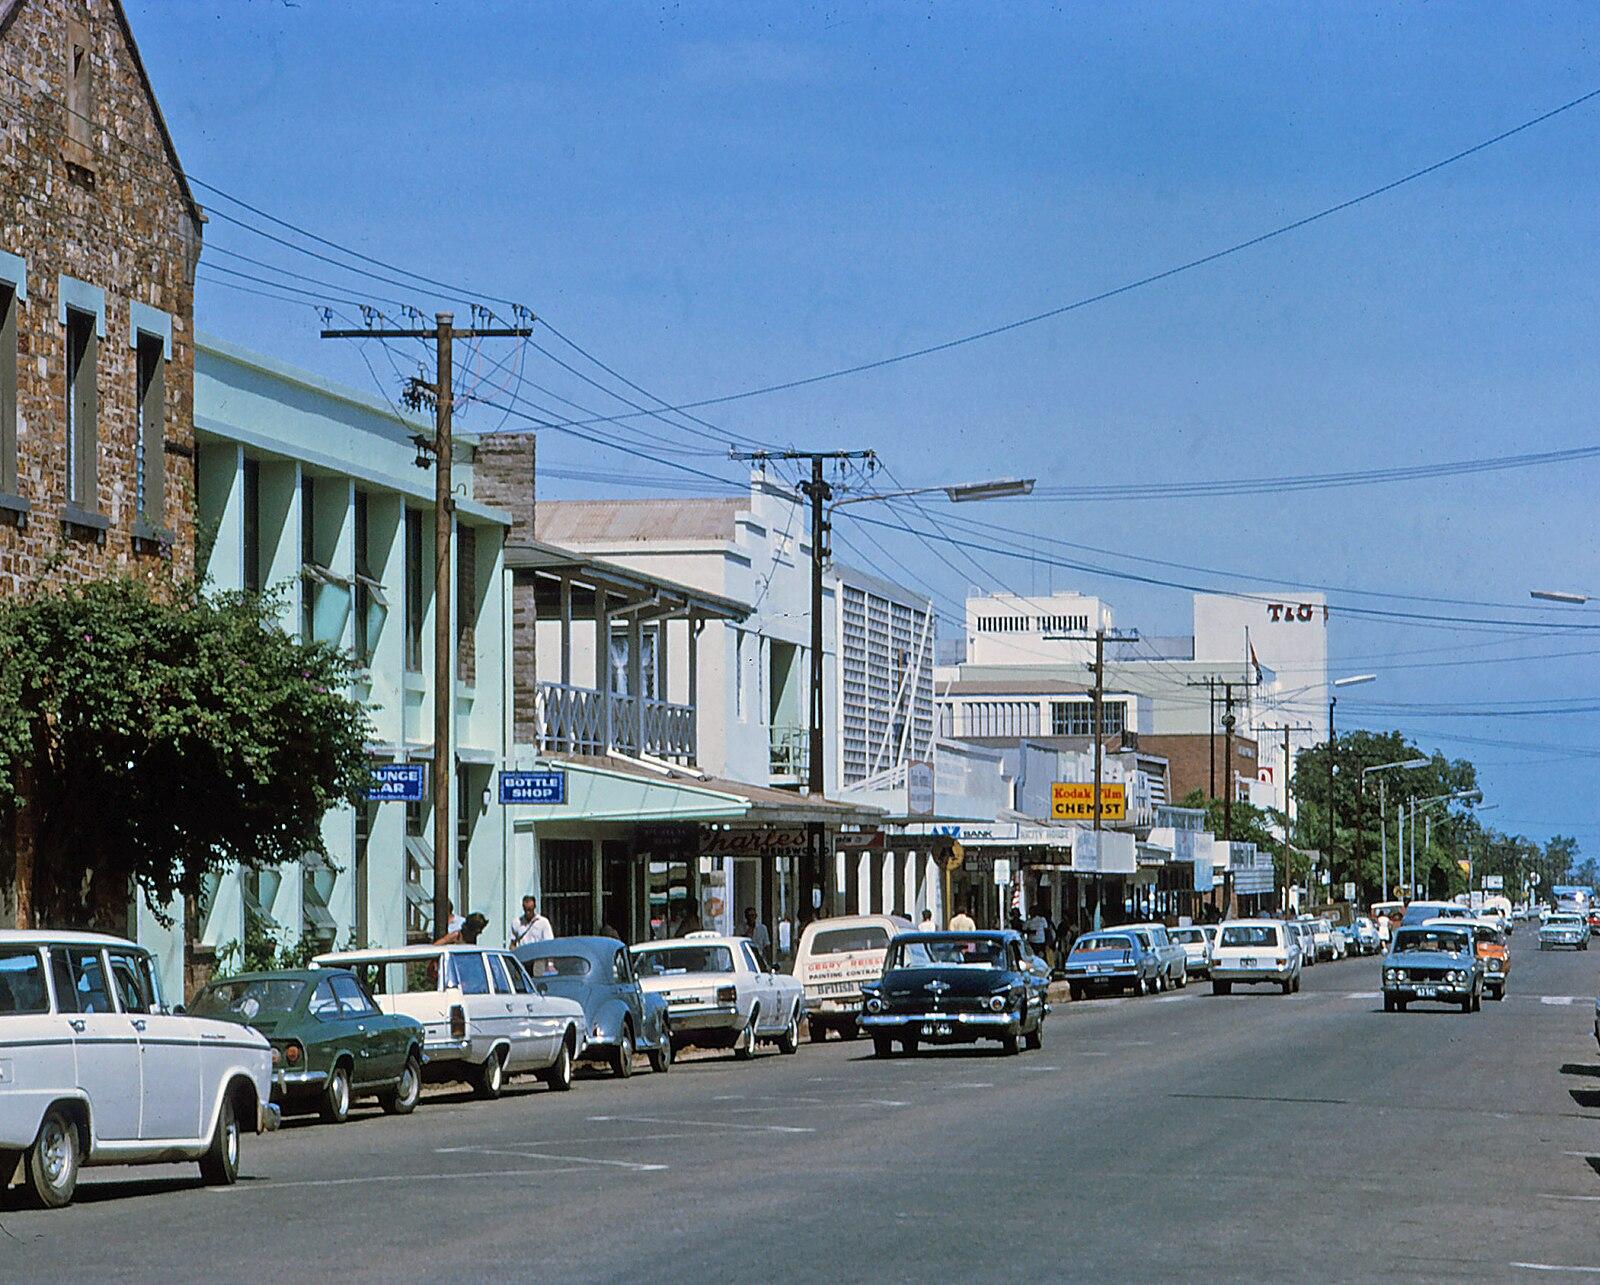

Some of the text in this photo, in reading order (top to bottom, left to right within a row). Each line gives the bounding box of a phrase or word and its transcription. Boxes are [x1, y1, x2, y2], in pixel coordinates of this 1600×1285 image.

[505, 778, 558, 787] BOTTLE
[512, 788, 553, 798] SHOP
[1055, 788, 1091, 799] Kodak
[963, 830, 993, 838] BANK
[809, 971, 843, 980] PAINTING
